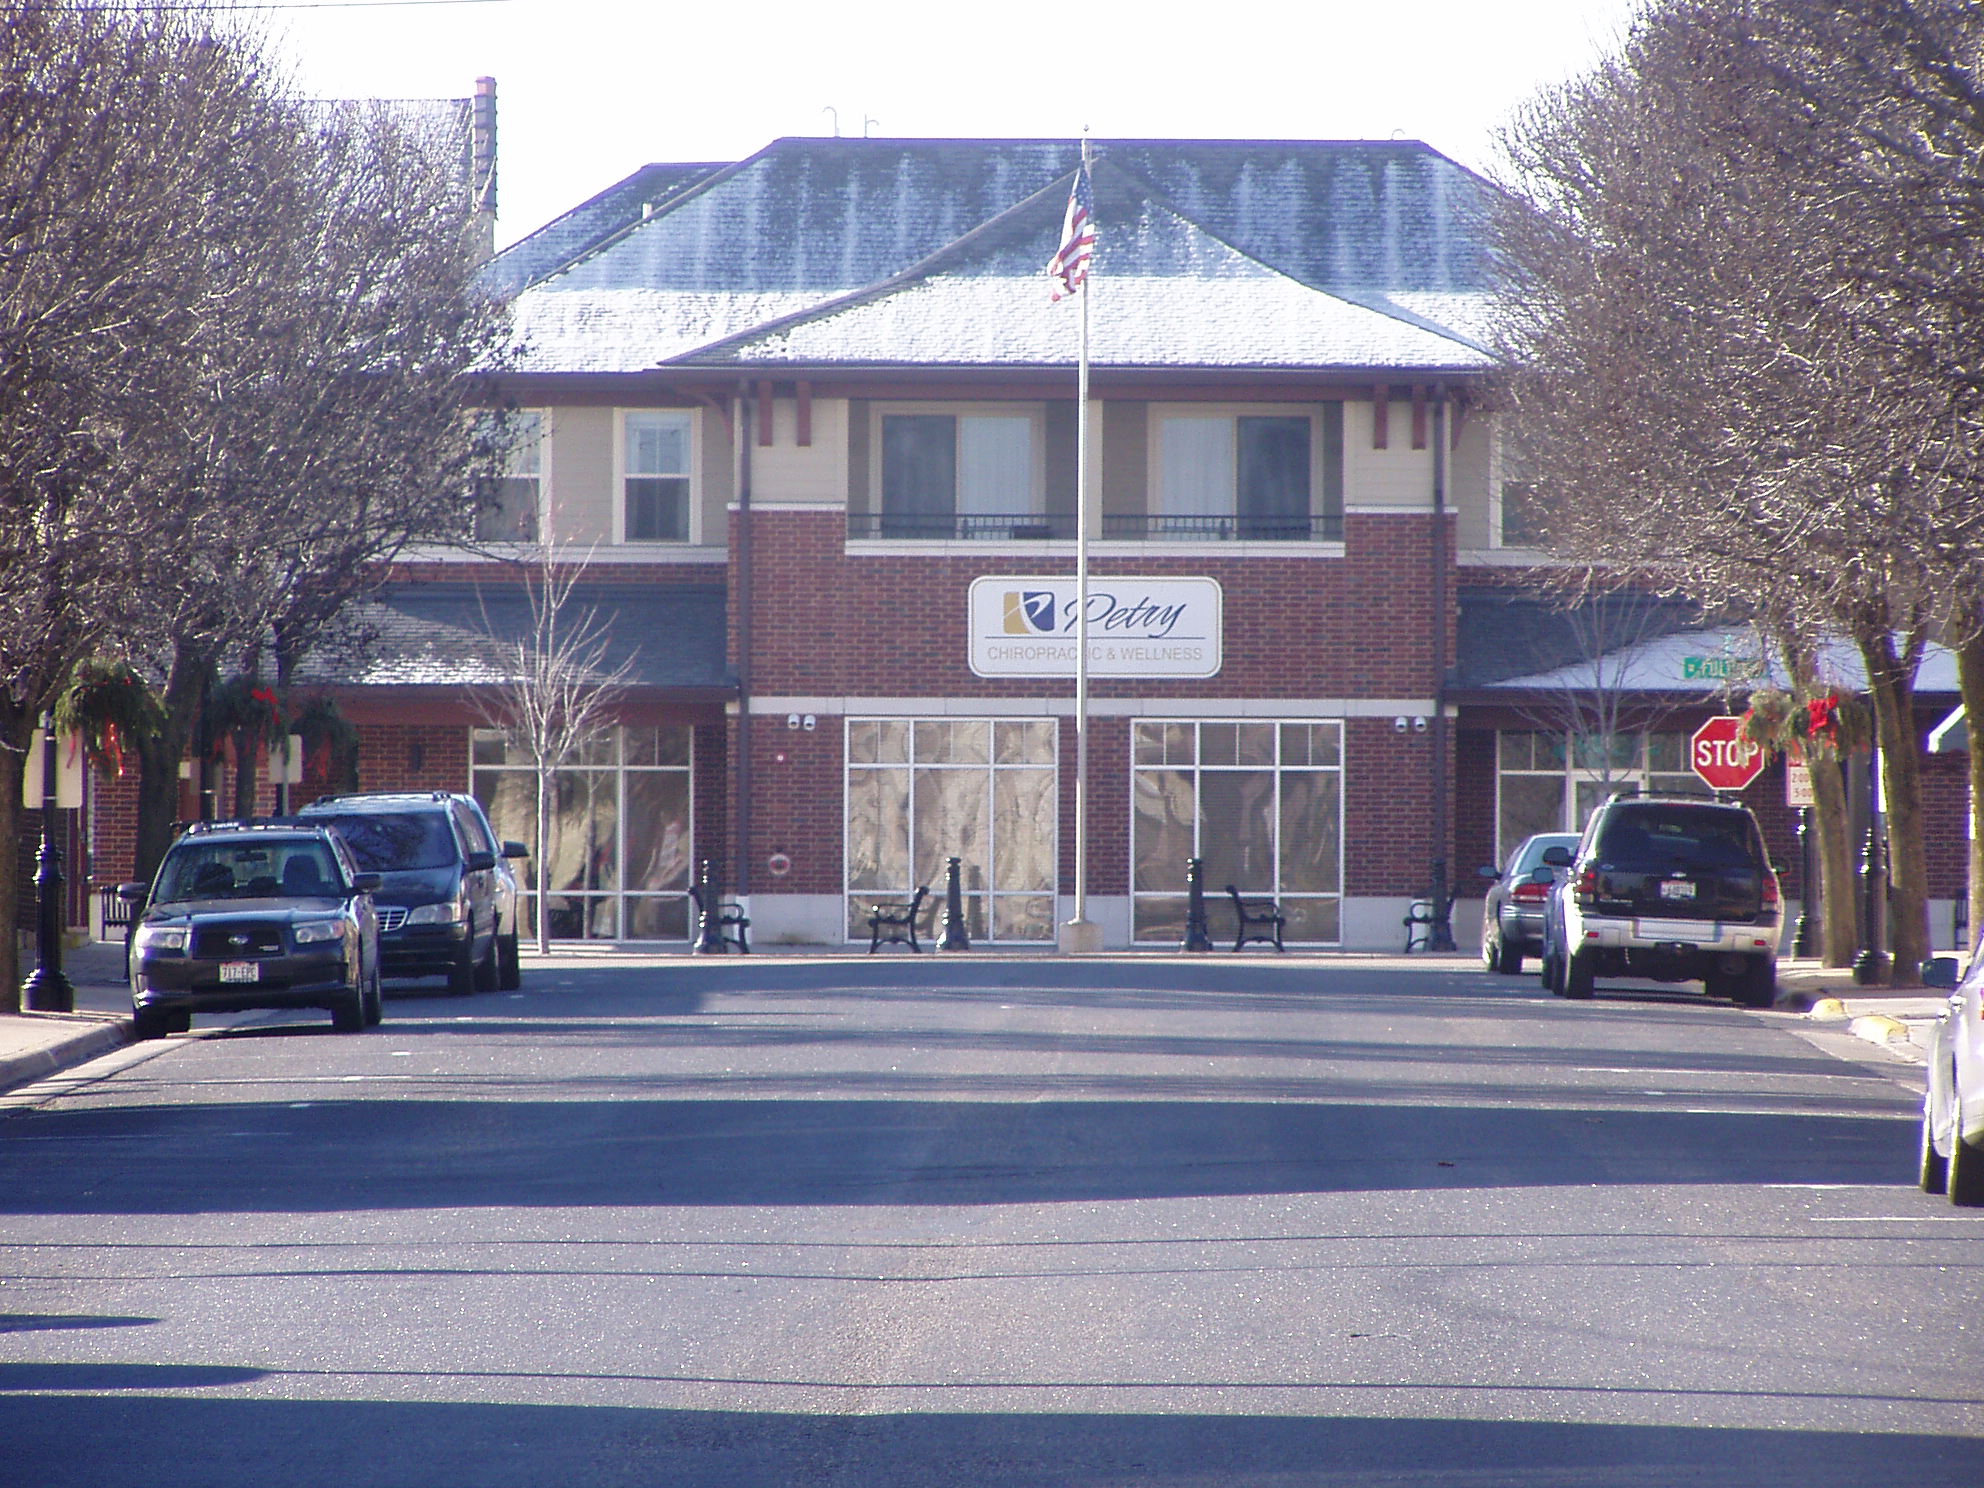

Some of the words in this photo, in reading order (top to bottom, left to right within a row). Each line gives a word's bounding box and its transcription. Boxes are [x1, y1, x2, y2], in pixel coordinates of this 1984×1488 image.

[1064, 593, 1188, 639] Petry
[987, 646, 1102, 661] CHIROPRACIC
[1107, 646, 1117, 661] &
[1120, 646, 1203, 661] WELLNESS
[1697, 739, 1759, 767] STOP
